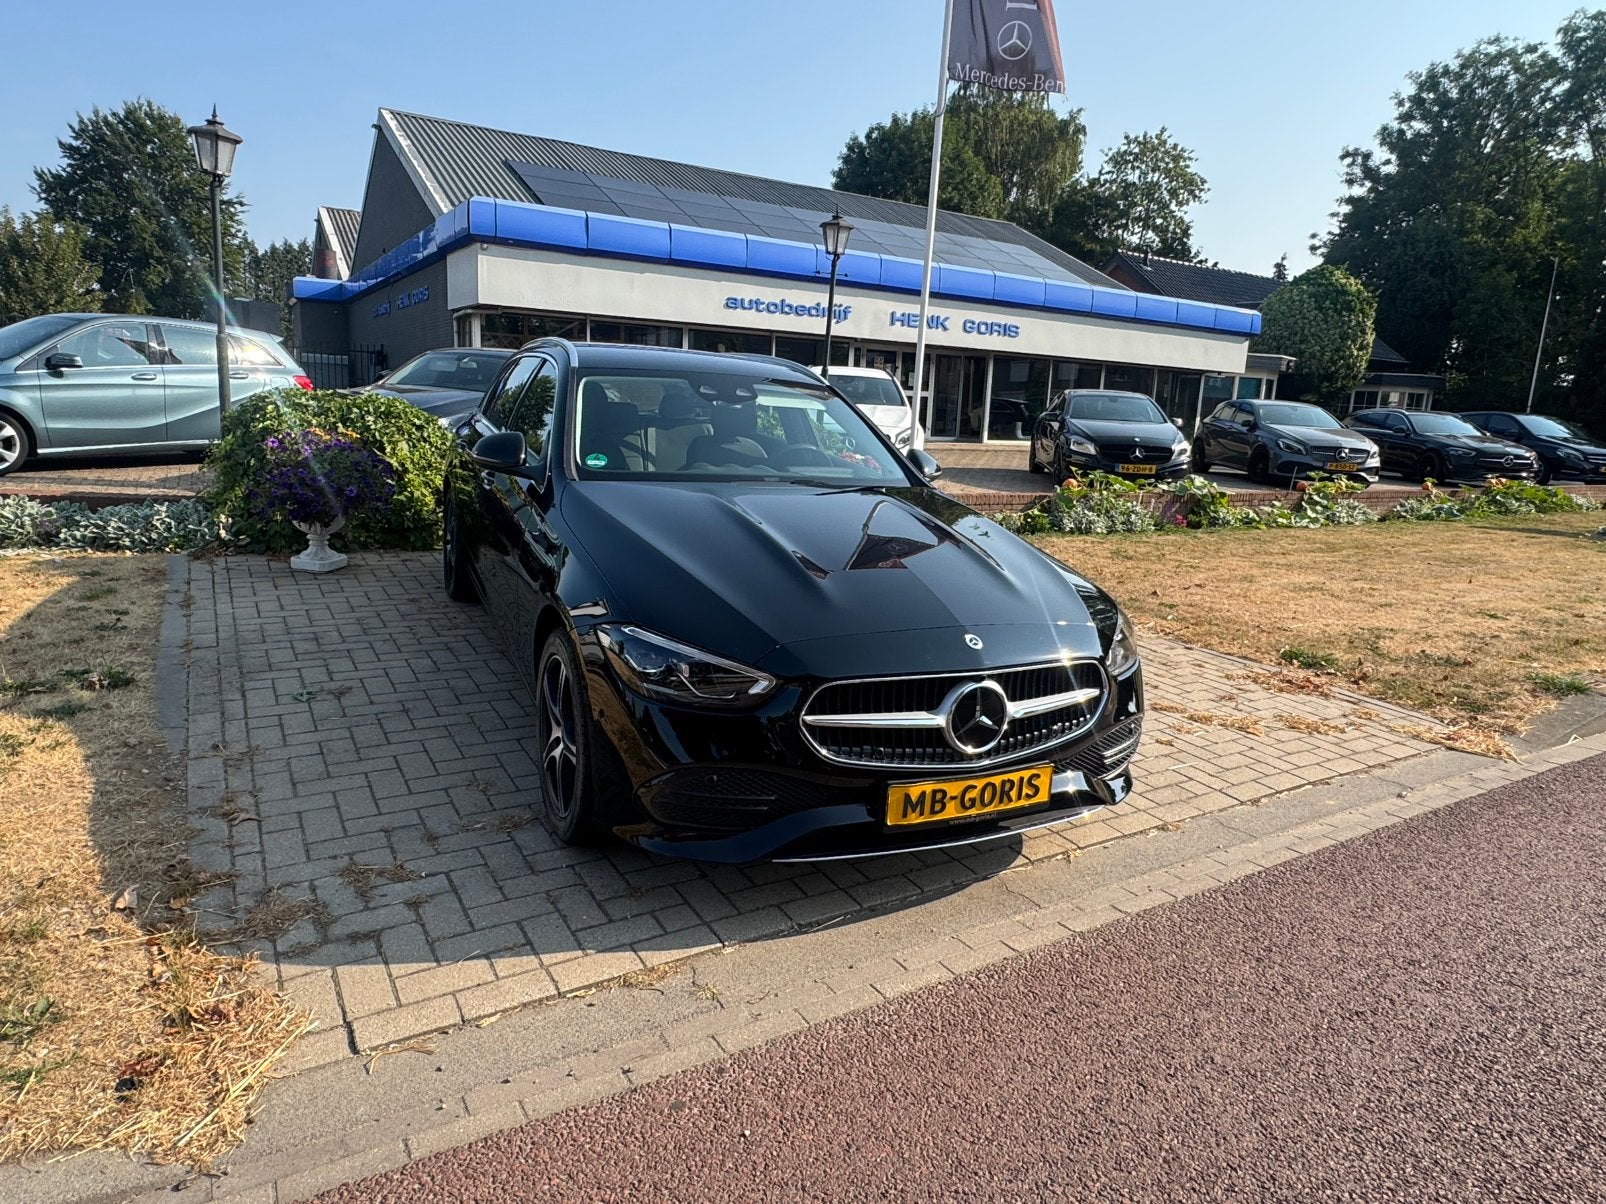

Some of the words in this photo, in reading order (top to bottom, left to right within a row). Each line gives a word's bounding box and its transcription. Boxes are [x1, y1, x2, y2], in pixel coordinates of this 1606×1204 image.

[955, 62, 1064, 92] Mercedes-Ben
[889, 310, 950, 332] HENK
[962, 318, 1020, 338] GORIS
[902, 773, 1041, 819] MB-GORIS
